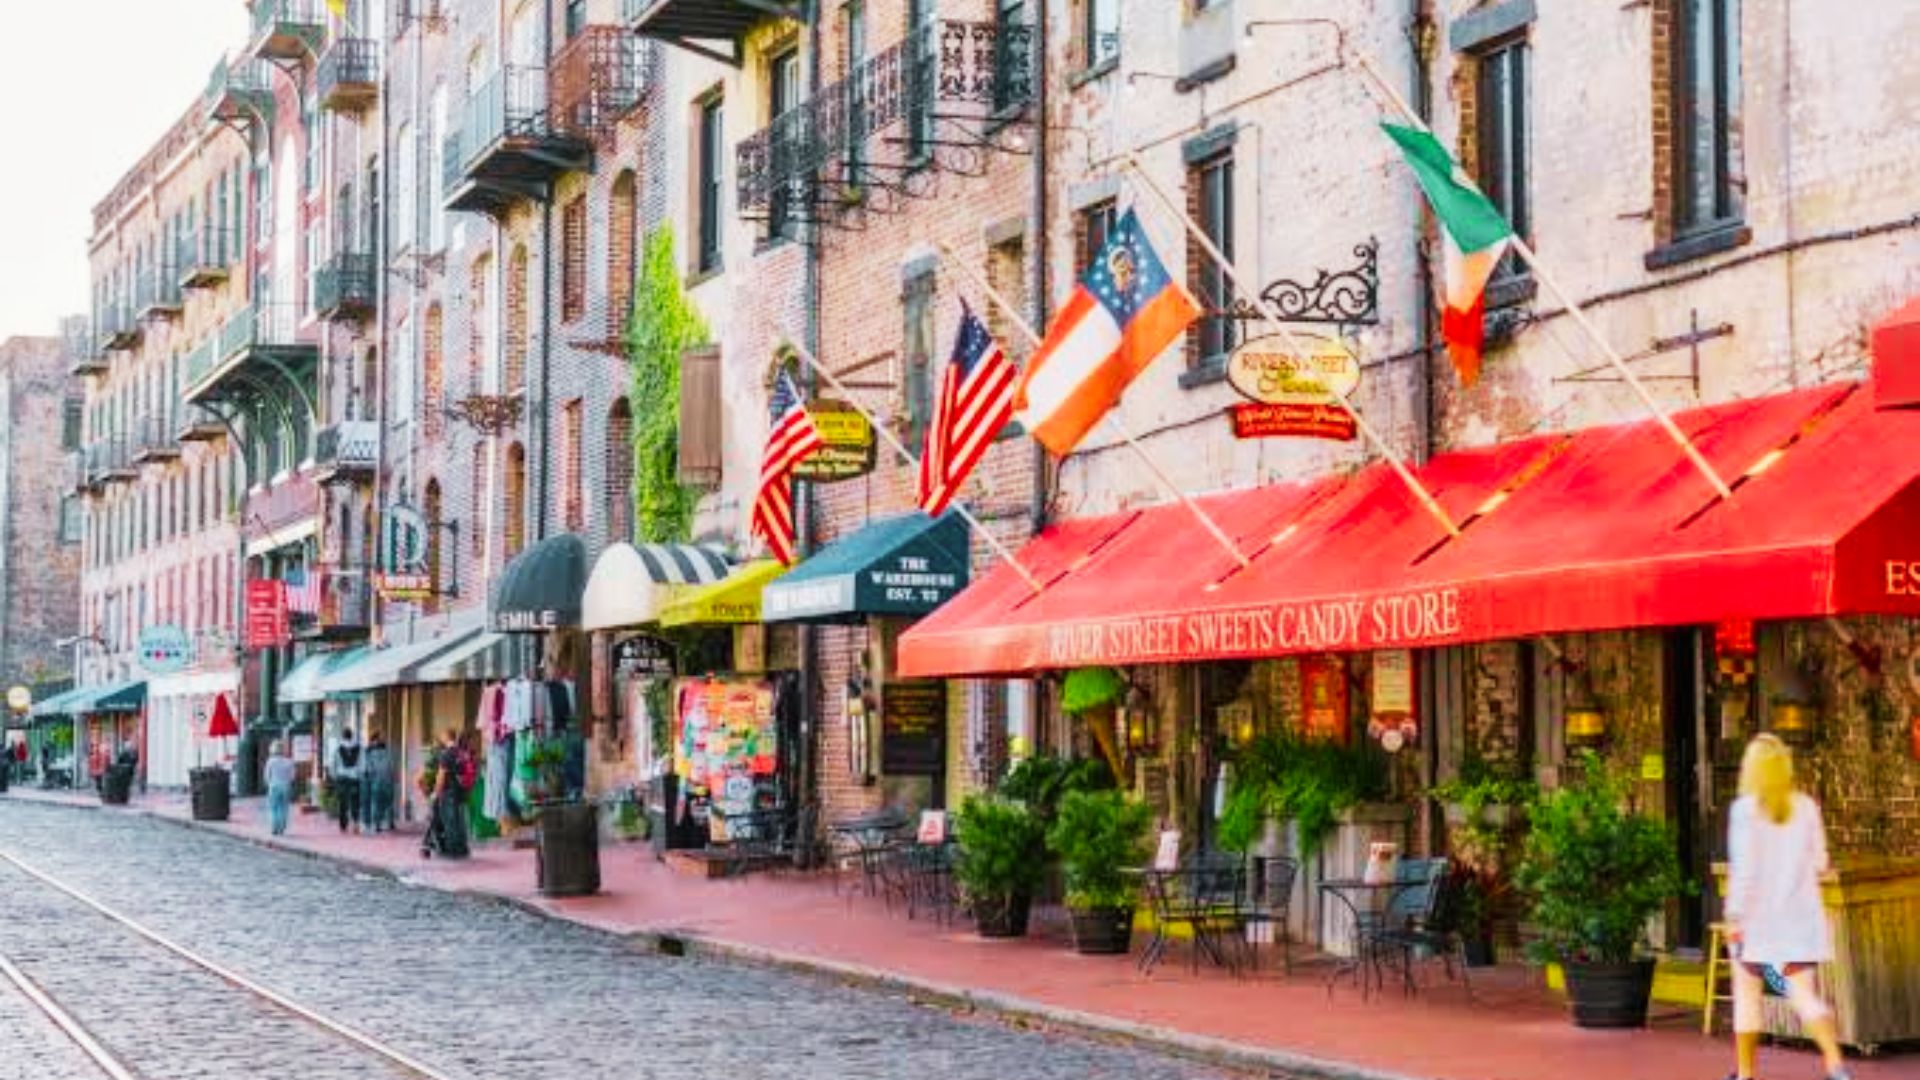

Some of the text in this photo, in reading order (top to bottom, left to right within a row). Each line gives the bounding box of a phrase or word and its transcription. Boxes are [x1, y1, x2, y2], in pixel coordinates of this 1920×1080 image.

[1291, 354, 1348, 373] SEET
[871, 569, 955, 588] WAREHOUSE
[497, 609, 557, 632] SMILE
[1049, 589, 1460, 662] RIVER STREET SWEETS CANDY STORE
